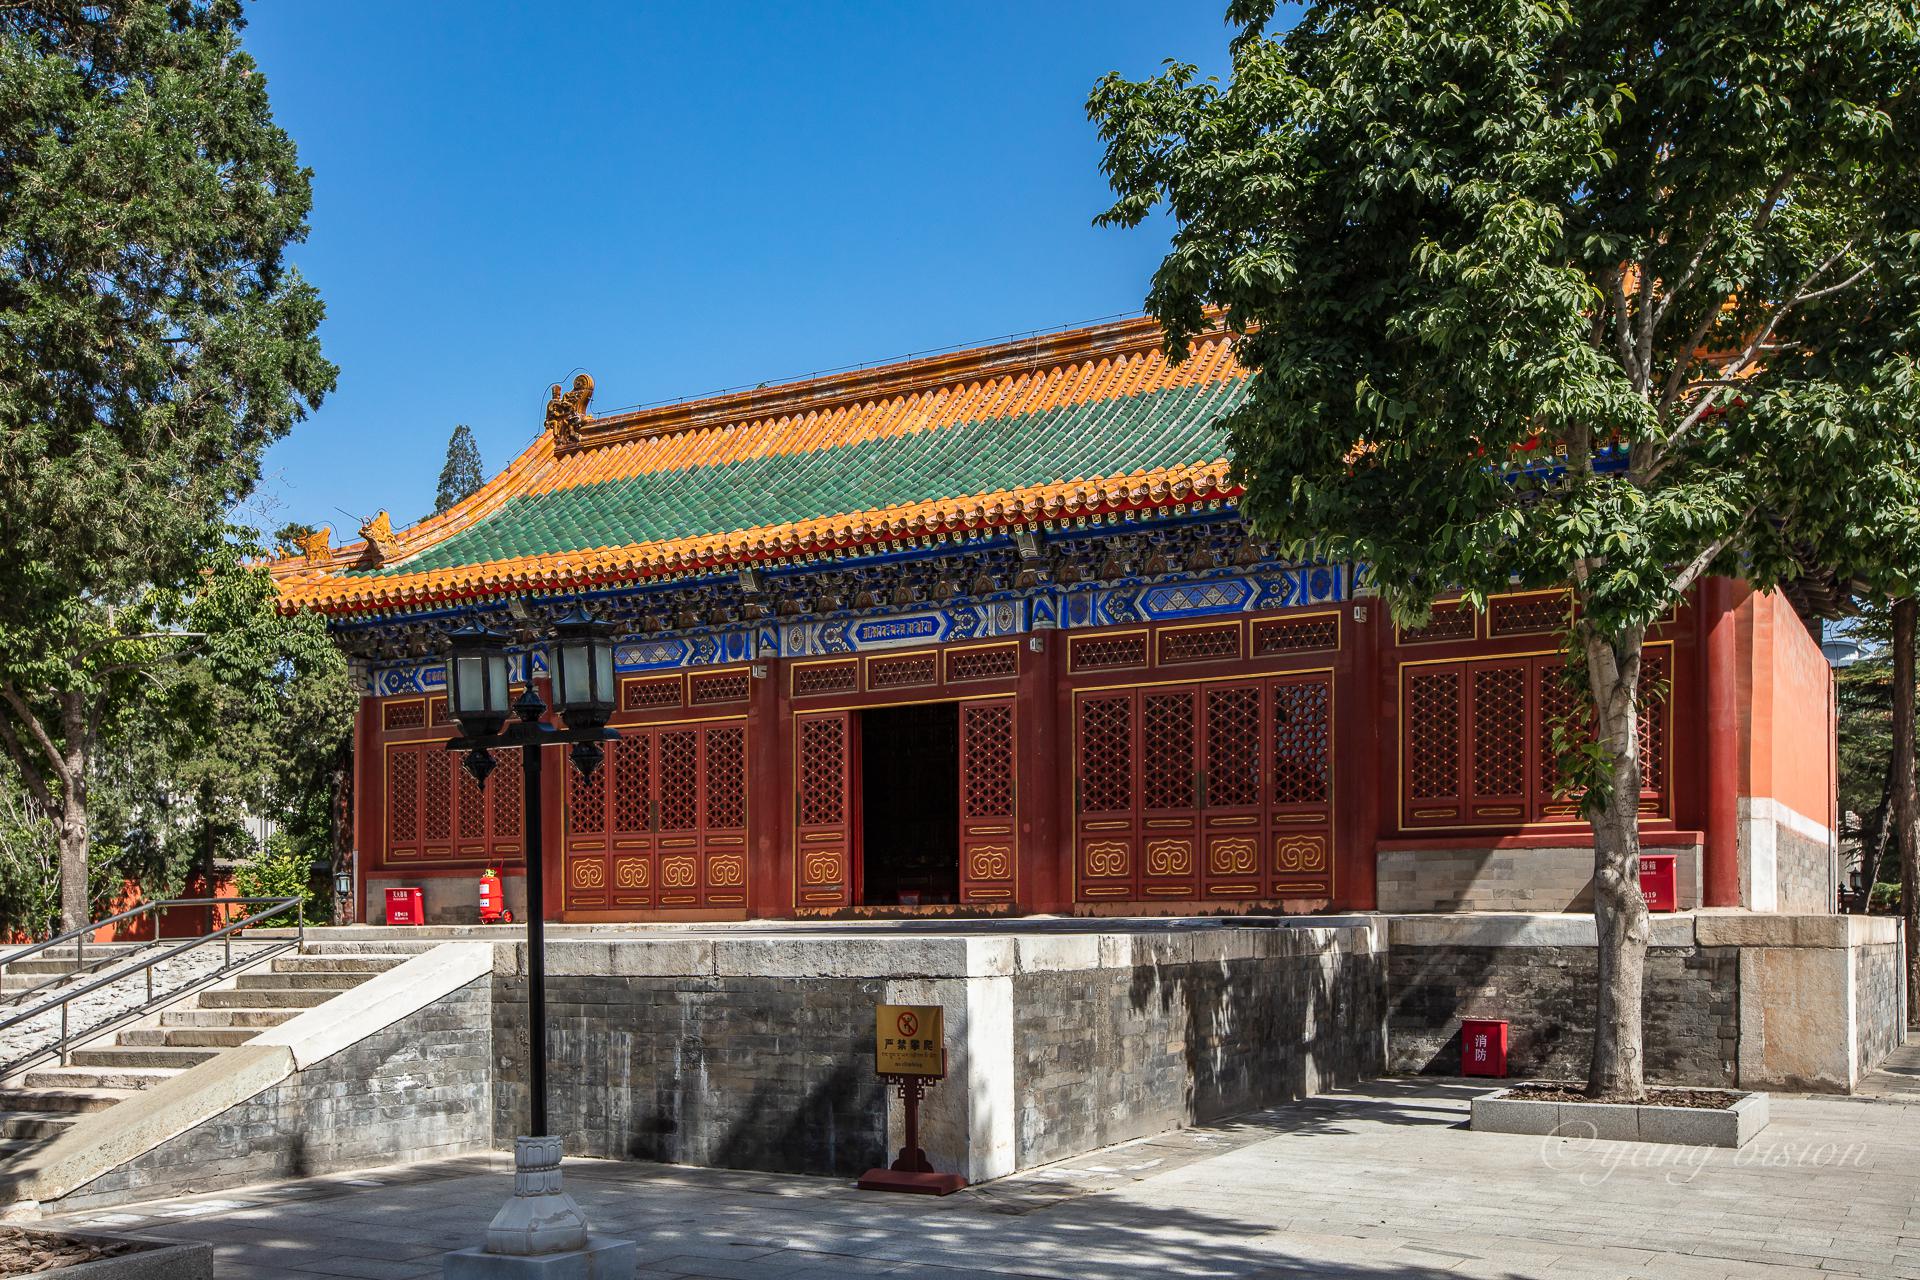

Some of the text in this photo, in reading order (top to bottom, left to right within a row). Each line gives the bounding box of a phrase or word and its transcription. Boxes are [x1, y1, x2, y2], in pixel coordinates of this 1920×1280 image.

[884, 1038, 933, 1051] 严禁攀爬
[1475, 1034, 1487, 1062] 消防
